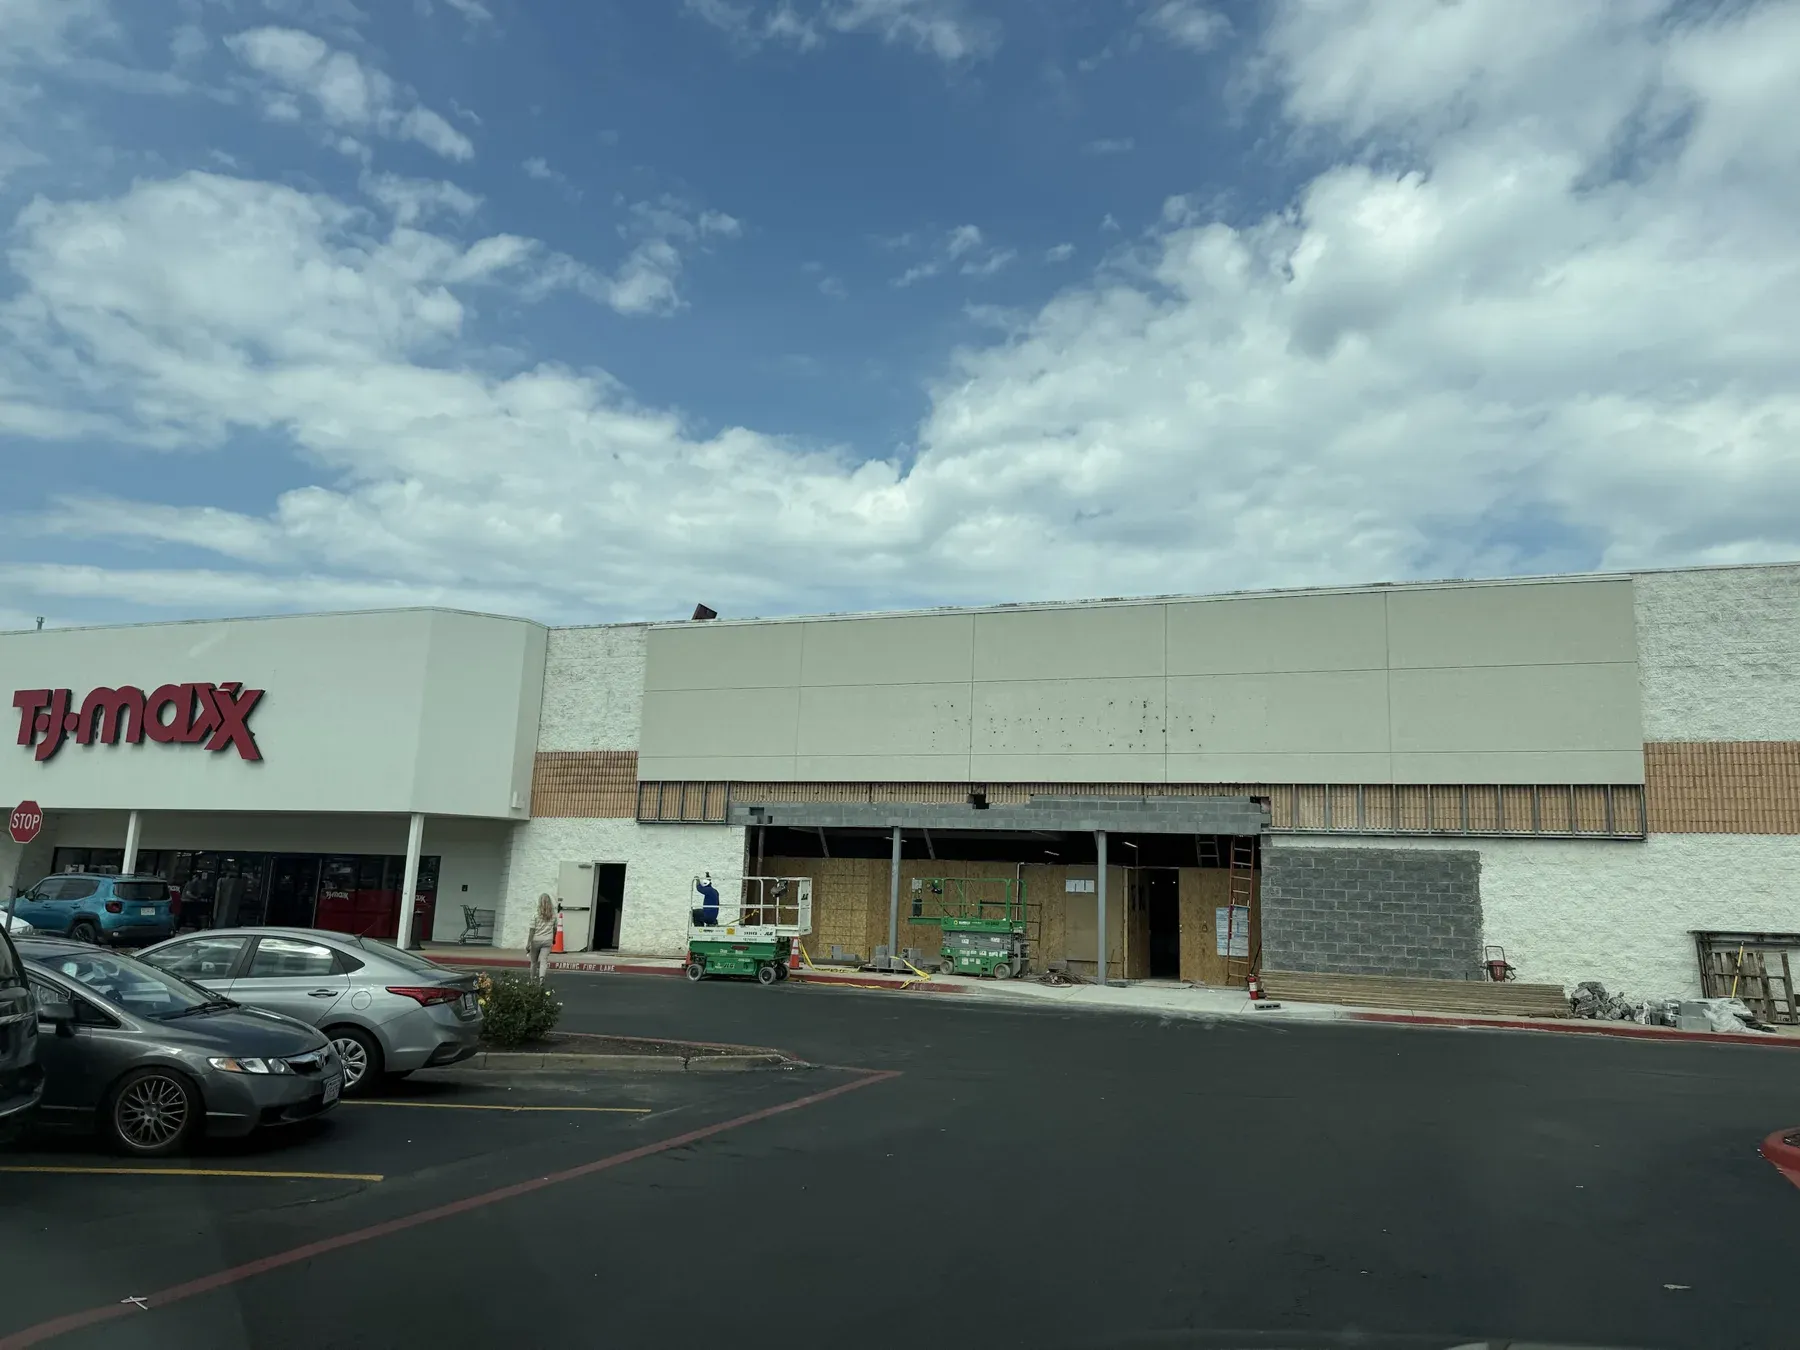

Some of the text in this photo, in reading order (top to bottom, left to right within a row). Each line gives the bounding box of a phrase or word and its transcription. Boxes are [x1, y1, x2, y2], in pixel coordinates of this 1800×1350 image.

[12, 812, 40, 830] STOP
[555, 962, 580, 970] PARKING
[583, 963, 597, 971] FIRE
[600, 964, 616, 972] LANE
